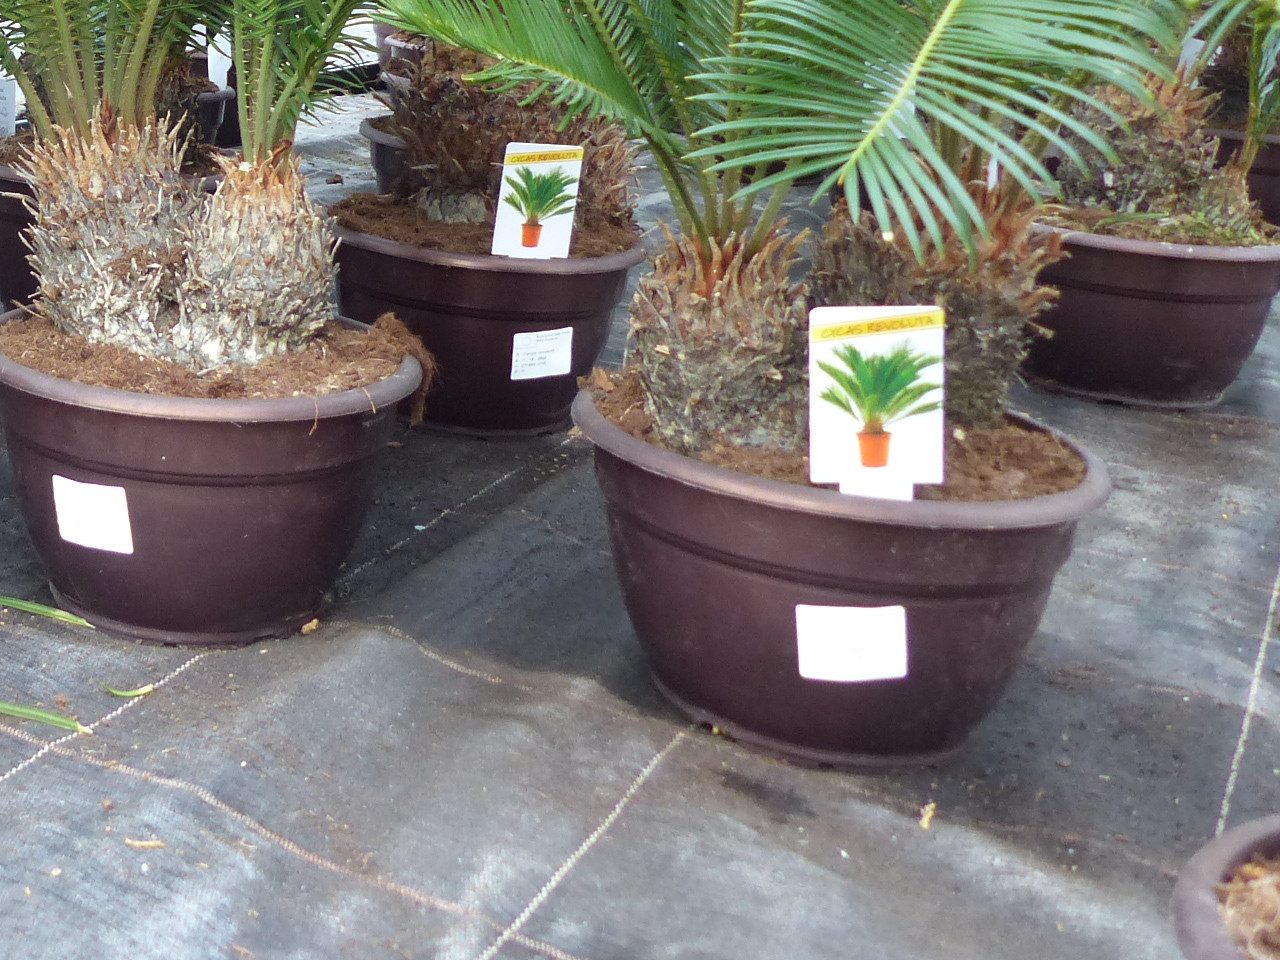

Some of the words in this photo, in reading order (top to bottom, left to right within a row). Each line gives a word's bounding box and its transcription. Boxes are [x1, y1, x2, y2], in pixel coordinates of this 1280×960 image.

[510, 153, 535, 163] CYCAS
[537, 151, 578, 162] REVOLUTA
[820, 324, 864, 339] CYCAS
[866, 315, 935, 334] REVOLUTA
